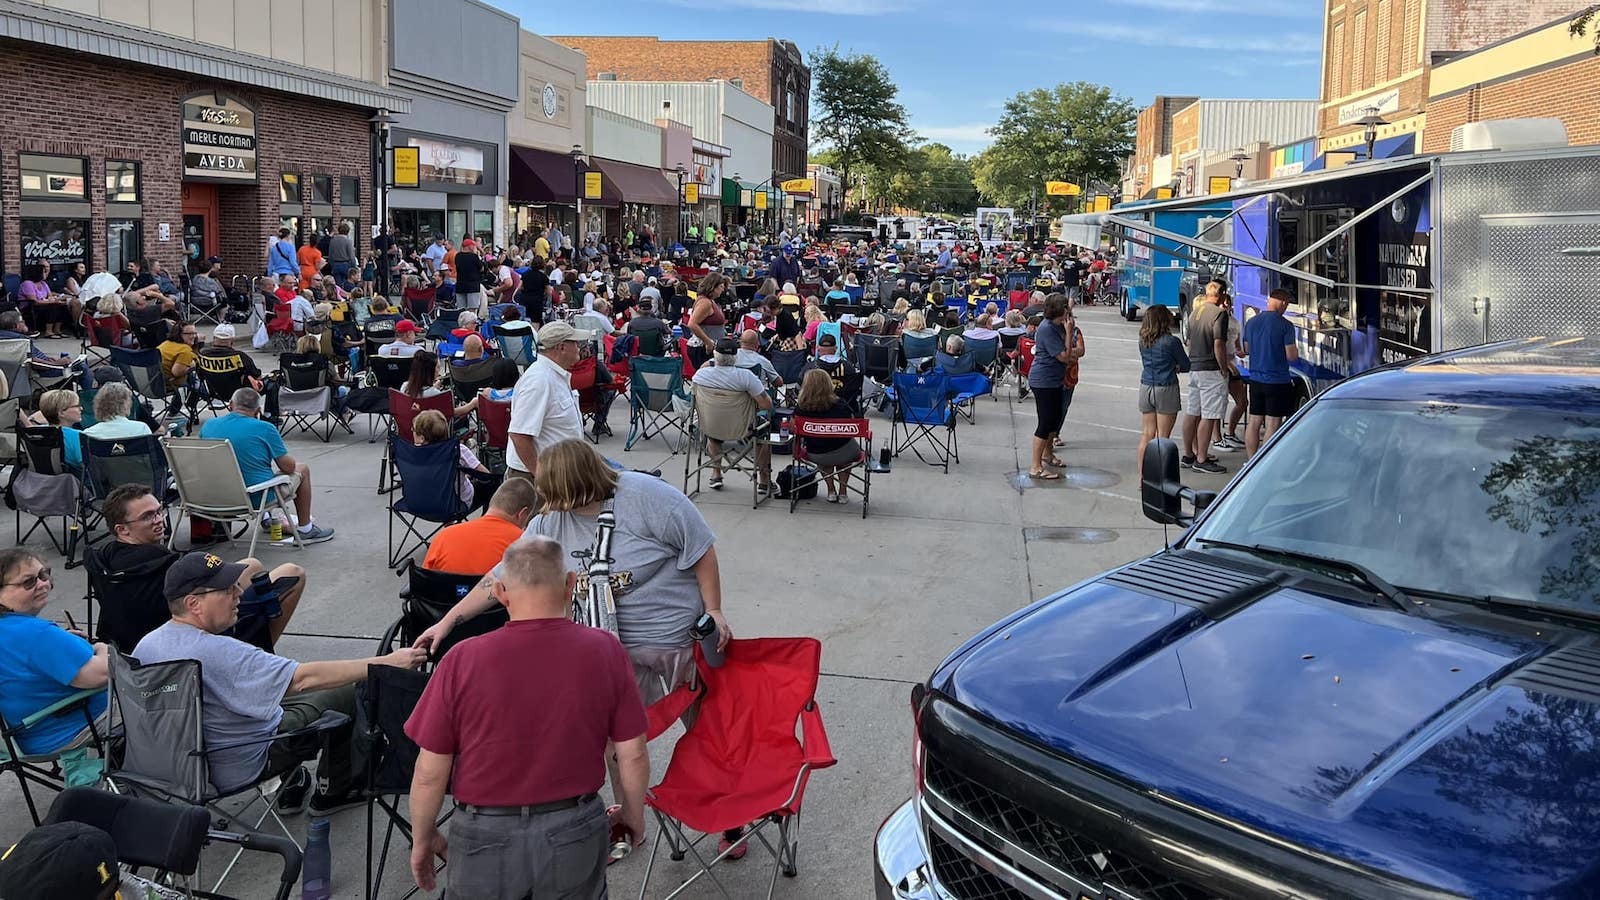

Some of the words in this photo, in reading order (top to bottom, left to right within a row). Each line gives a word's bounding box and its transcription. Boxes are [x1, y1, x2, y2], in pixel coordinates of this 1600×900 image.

[201, 108, 240, 124] VitaSuite
[190, 131, 217, 144] MERLE
[219, 135, 251, 148] NORMAN
[200, 154, 245, 169] AVEDA
[24, 238, 84, 258] VitaSuite
[1379, 243, 1428, 267] NATURALLY
[1387, 267, 1417, 289] RAISED
[199, 357, 236, 371] IOWA
[805, 423, 857, 433] GUIDESMAN
